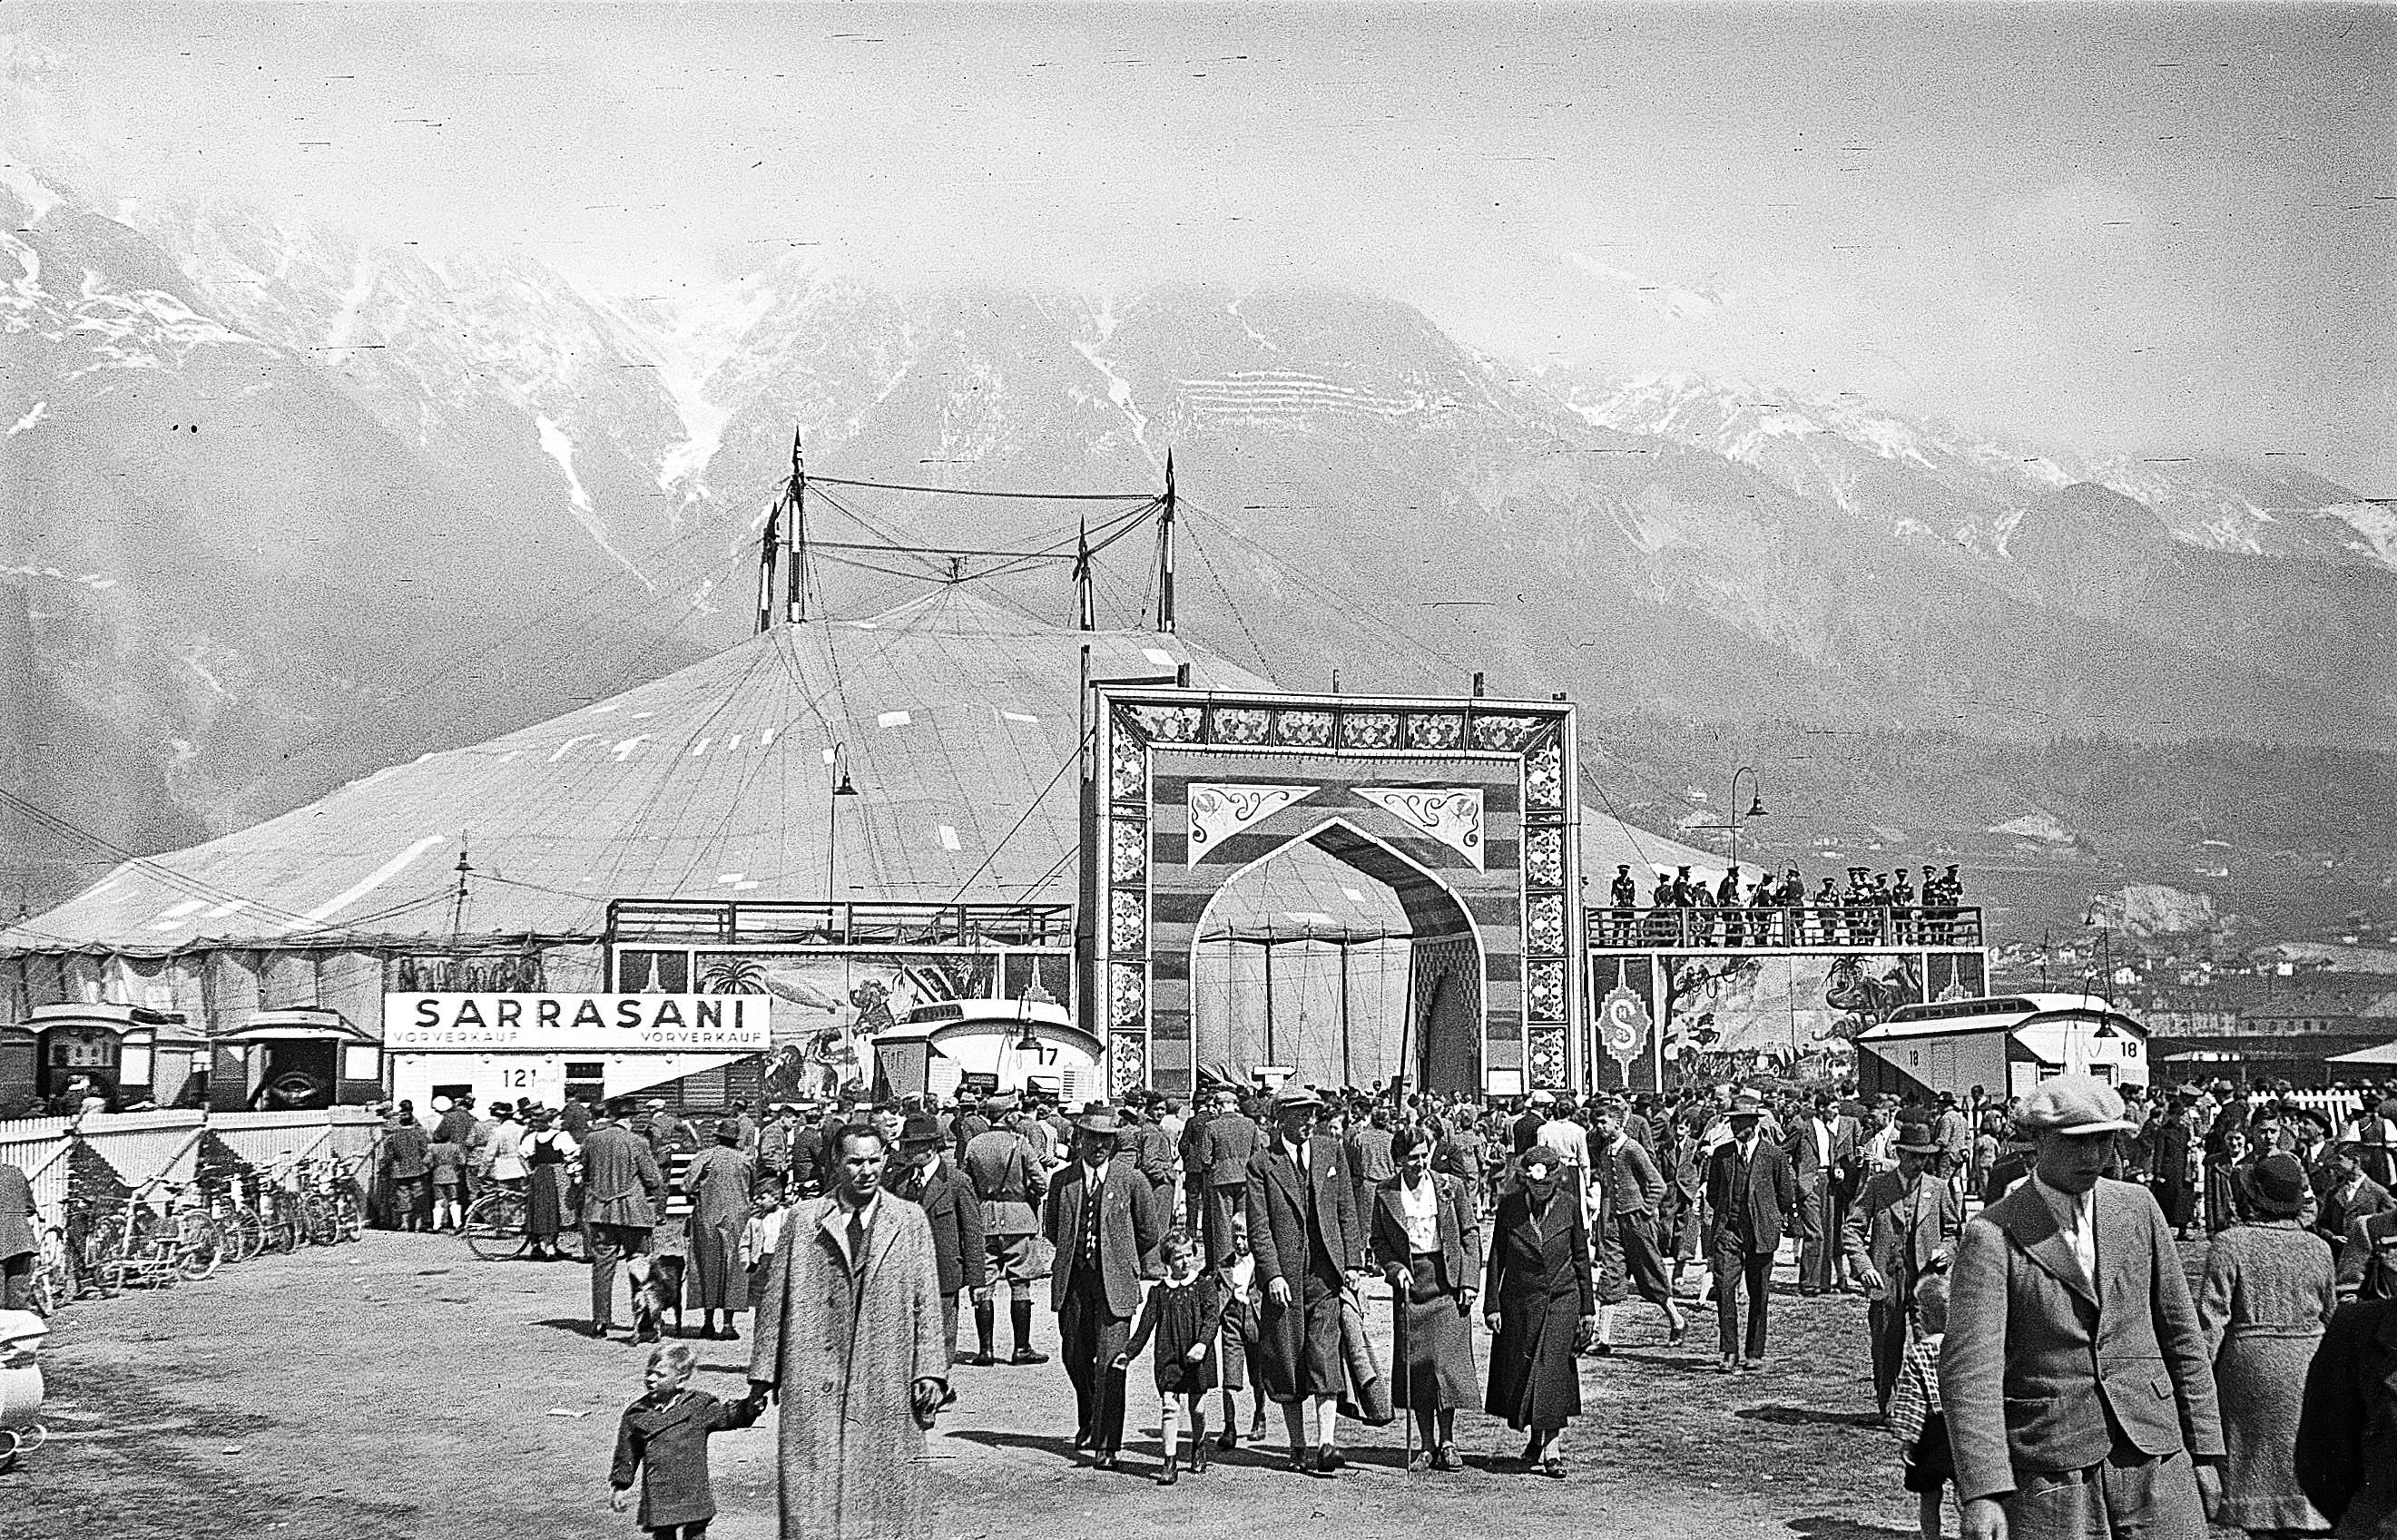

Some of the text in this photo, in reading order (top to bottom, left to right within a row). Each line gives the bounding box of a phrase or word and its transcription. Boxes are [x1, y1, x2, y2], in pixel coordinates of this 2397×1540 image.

[415, 998, 743, 1028] SARRASANI
[1610, 998, 1636, 1050] S
[393, 1031, 518, 1043] VORVERKAUF
[641, 1031, 761, 1043] VORVERKAUF
[1037, 1047, 1058, 1066] 17
[1909, 1049, 1920, 1067] 18
[2120, 1041, 2137, 1058] 18
[504, 1068, 536, 1088] 121
